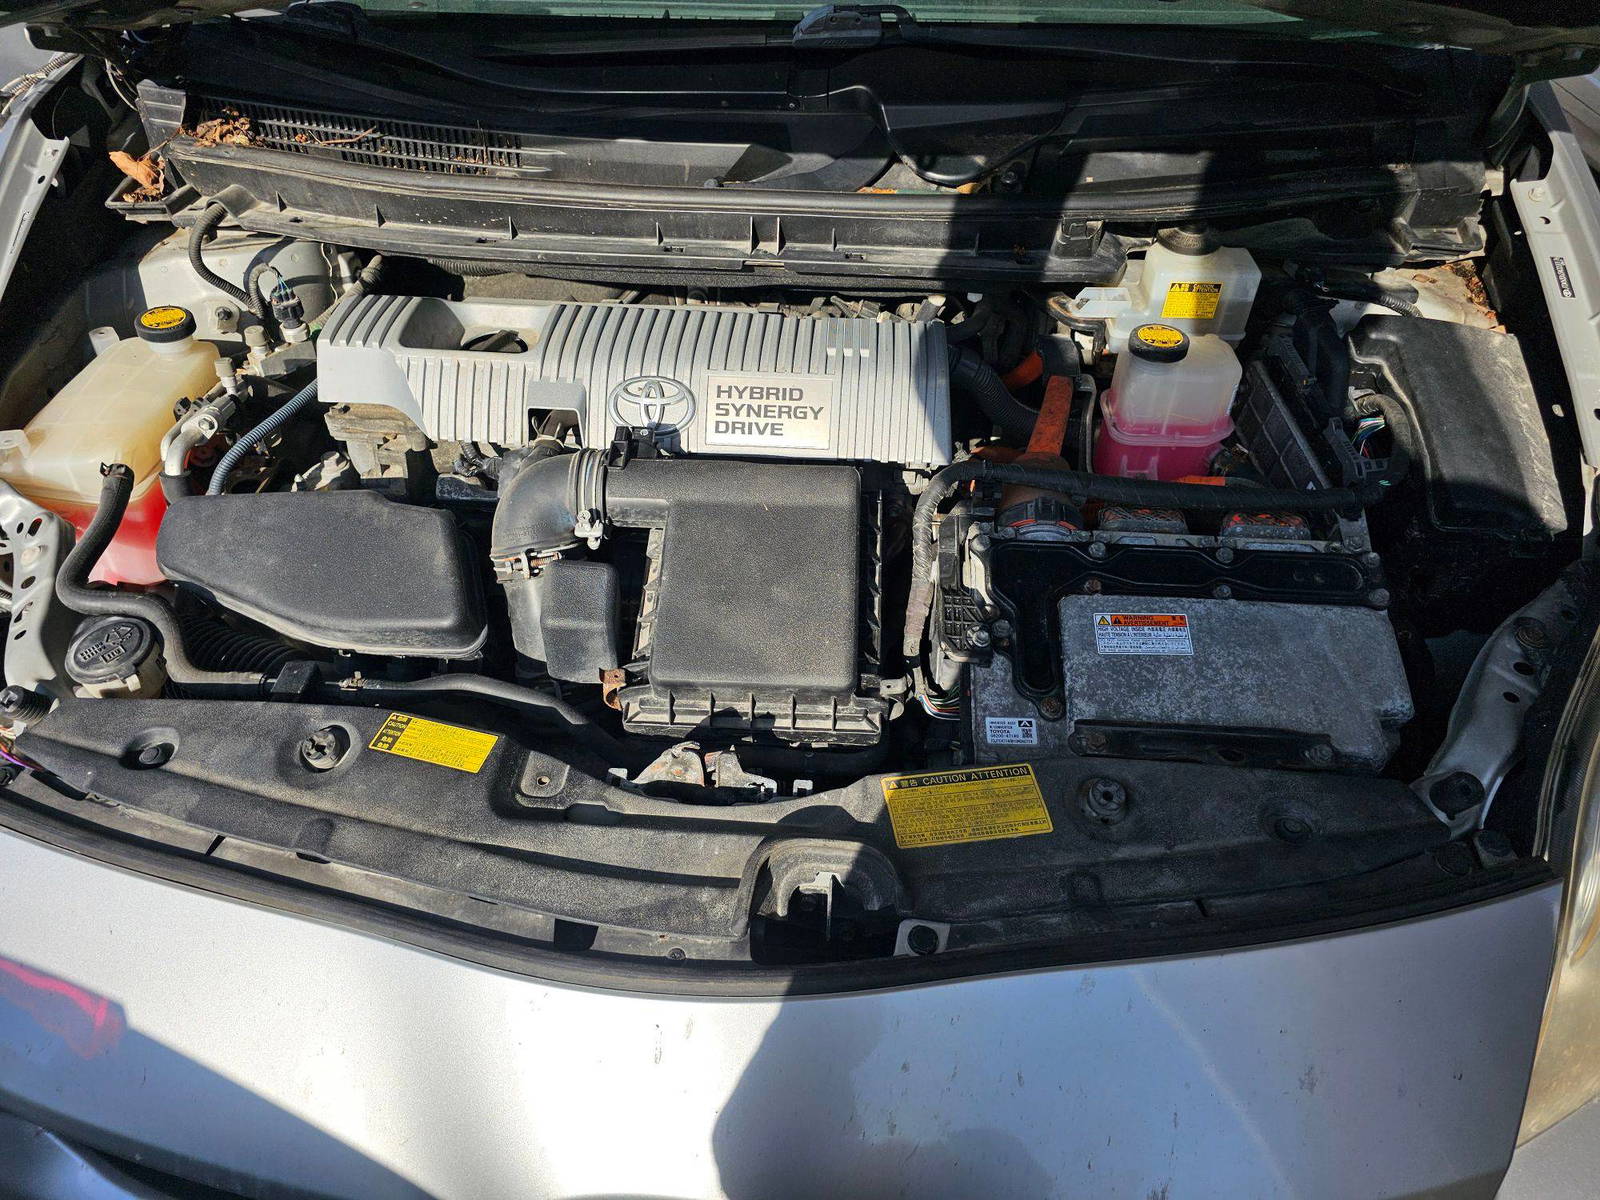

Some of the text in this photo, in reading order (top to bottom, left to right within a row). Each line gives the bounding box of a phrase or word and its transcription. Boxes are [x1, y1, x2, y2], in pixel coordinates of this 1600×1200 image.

[716, 385, 804, 402] HYBRID
[715, 403, 824, 421] SYNERGY
[714, 420, 784, 437] DRIVE
[922, 774, 966, 786] CAUTION
[971, 767, 1028, 781] ATTENTION
